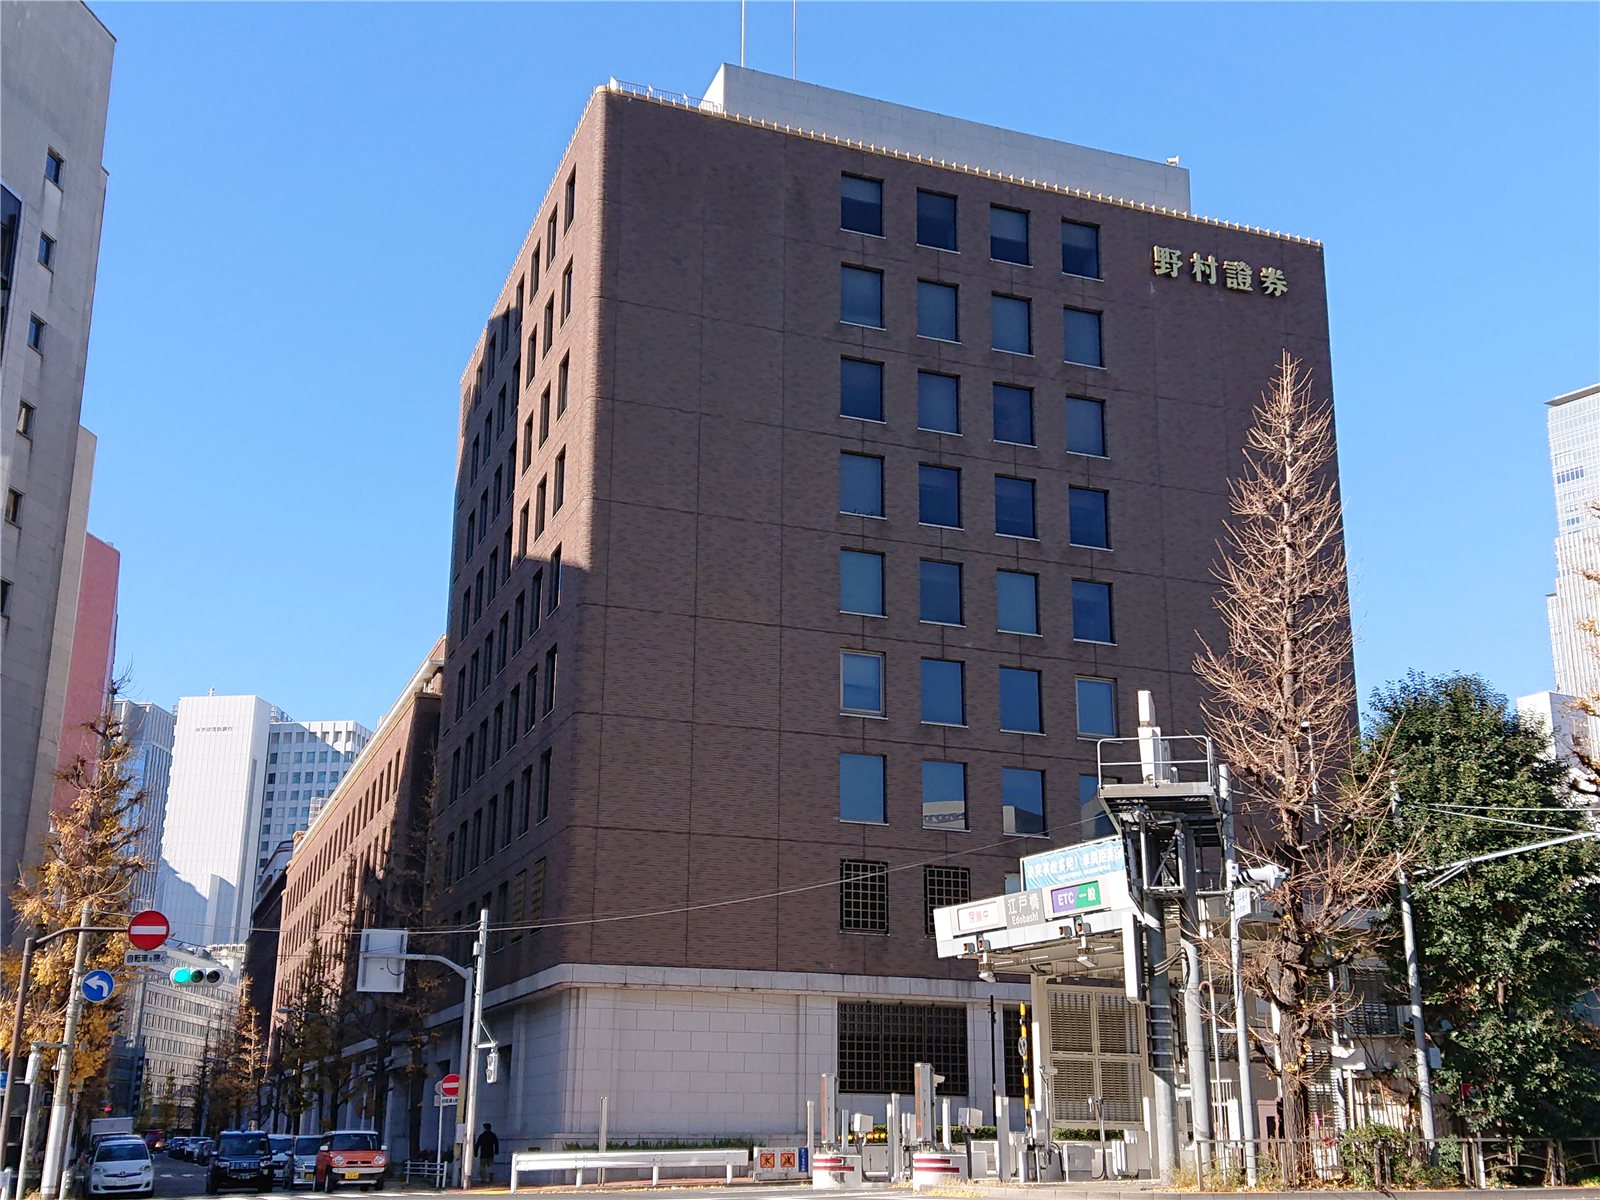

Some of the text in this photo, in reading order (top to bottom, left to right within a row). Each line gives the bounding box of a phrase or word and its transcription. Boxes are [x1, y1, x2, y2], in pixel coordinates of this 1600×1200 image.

[1153, 245, 1289, 297] 野村證券
[1008, 893, 1040, 914] 江戸橋
[1057, 886, 1097, 906] ETC 一般
[1012, 911, 1039, 925] Edobashi
